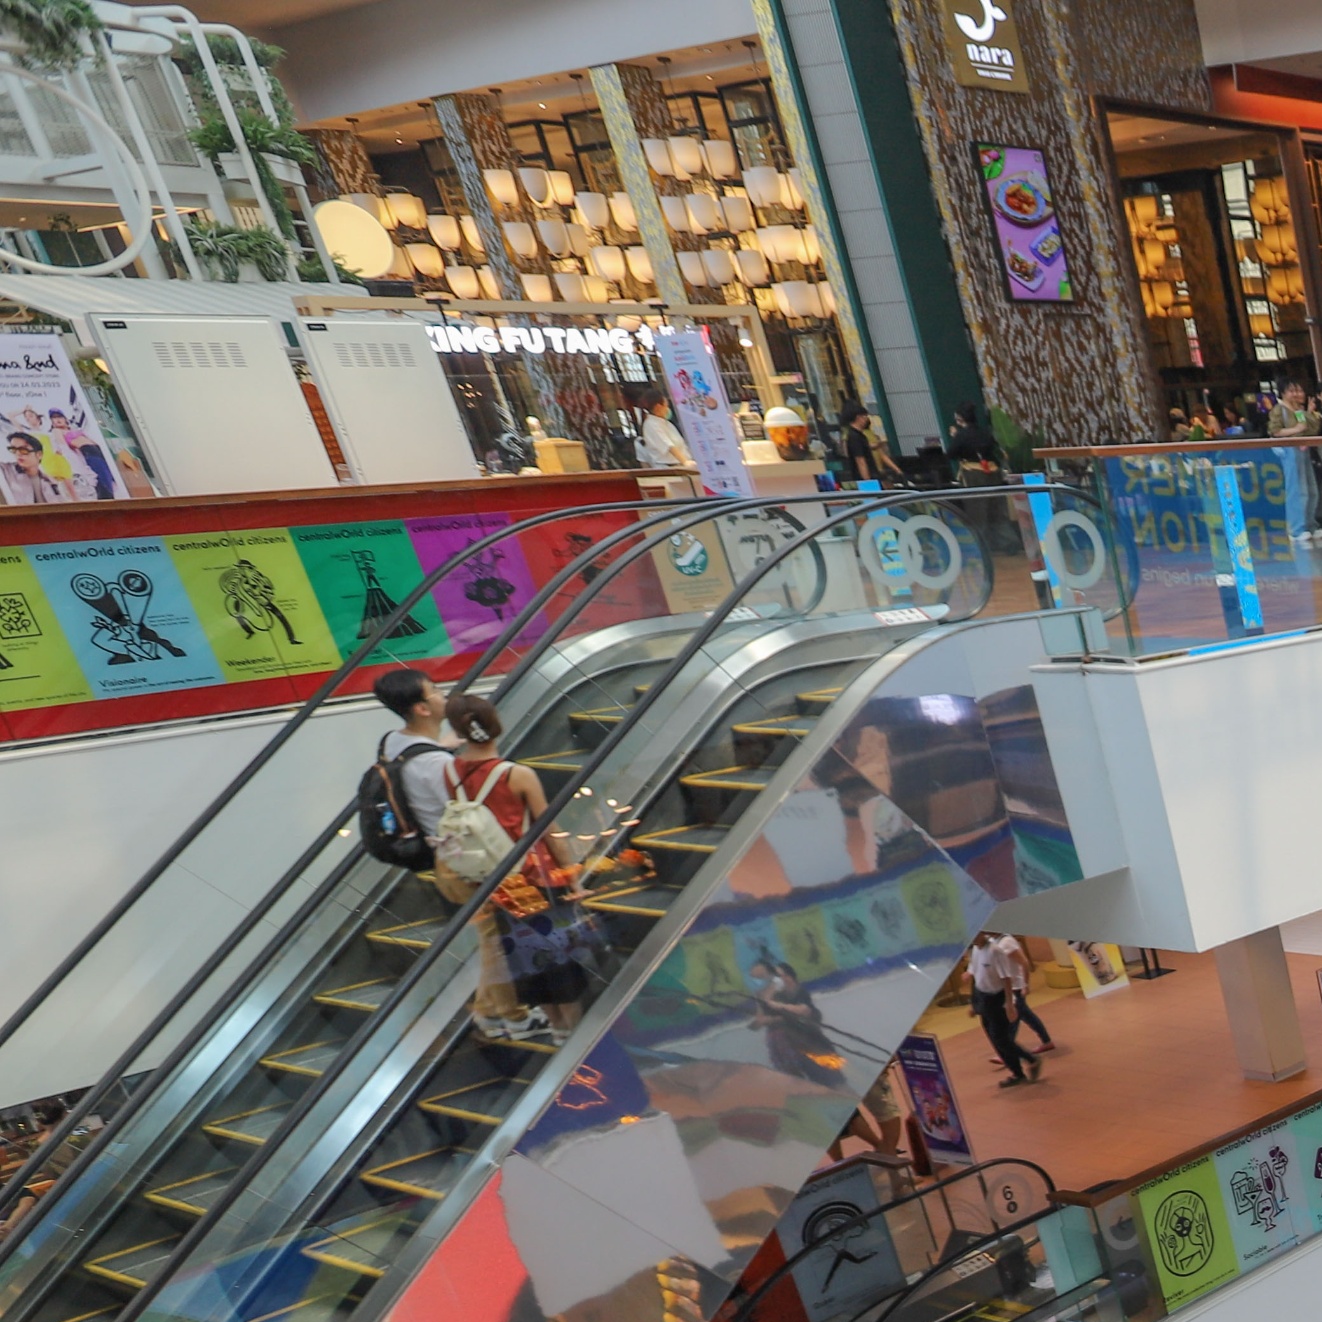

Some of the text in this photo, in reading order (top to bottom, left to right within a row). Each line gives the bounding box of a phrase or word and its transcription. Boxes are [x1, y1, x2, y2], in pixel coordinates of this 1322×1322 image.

[966, 43, 1014, 67] nara
[500, 326, 546, 353] FU
[545, 328, 634, 354] TANG
[298, 525, 403, 543] centralwOrld citizens
[172, 535, 288, 552] centralwOrld citizens
[35, 546, 114, 563] centralwOrld
[117, 543, 161, 556] citizens
[225, 655, 277, 668] Weekender
[99, 676, 148, 688] Visionaire
[1215, 1119, 1288, 1158] centralwOrld citizens
[1181, 1156, 1209, 1174] citizens
[1243, 1243, 1269, 1261] Sociable
